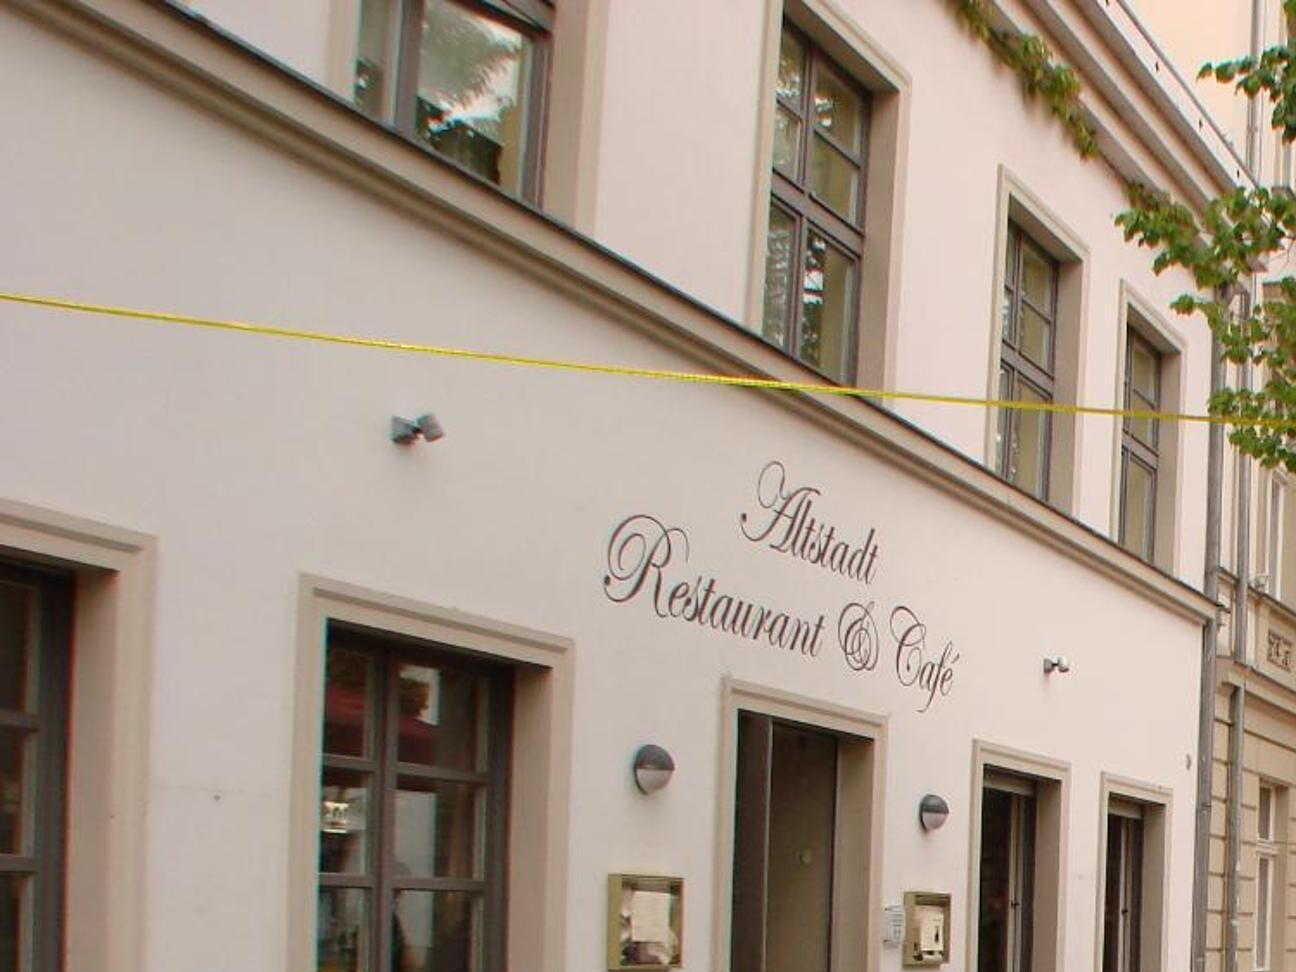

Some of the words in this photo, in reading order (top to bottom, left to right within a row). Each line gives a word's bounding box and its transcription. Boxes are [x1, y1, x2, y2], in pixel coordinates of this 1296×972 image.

[739, 460, 880, 585] Altstadt
[603, 514, 826, 659] Restaurant
[836, 600, 880, 672] &
[889, 605, 962, 714] Café
